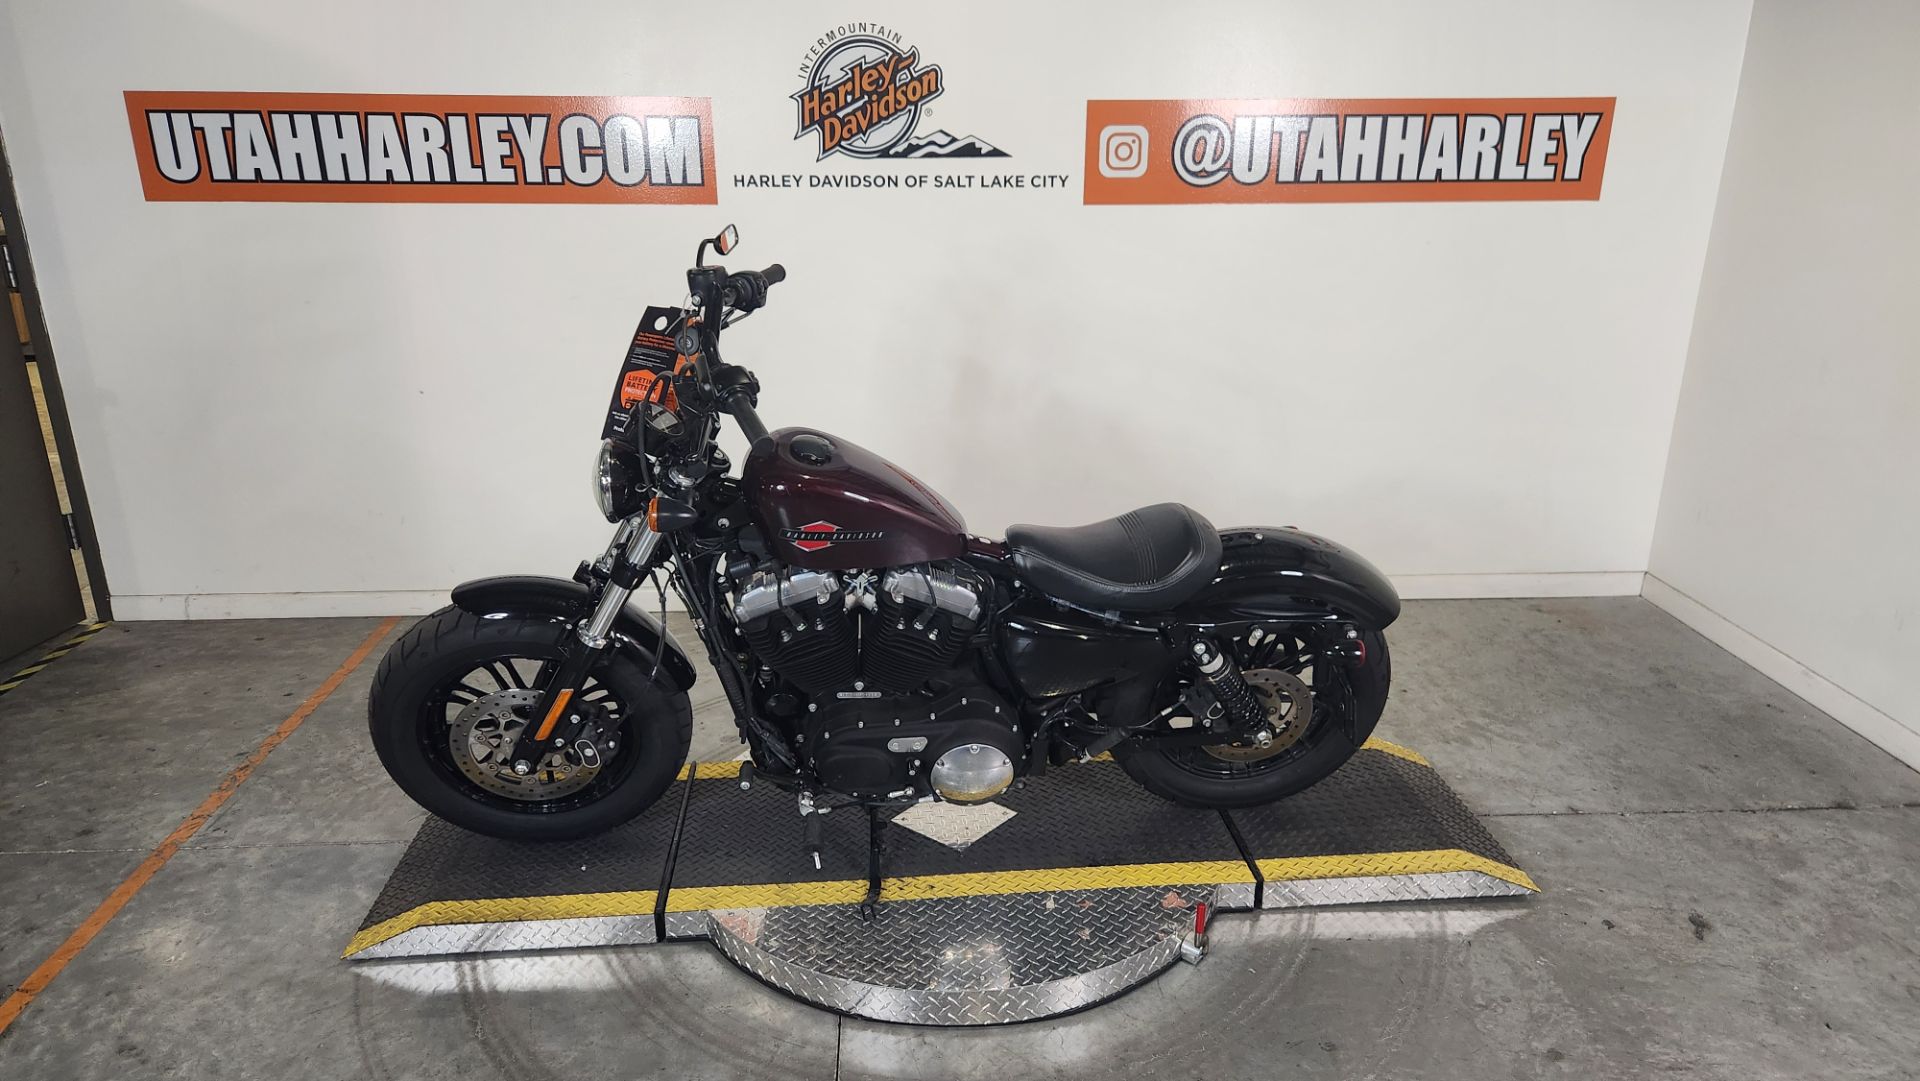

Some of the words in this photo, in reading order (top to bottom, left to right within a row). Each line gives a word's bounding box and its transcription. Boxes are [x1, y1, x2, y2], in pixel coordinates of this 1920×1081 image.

[798, 22, 902, 79] INTERMOUNTAIN
[823, 68, 939, 151] Davidson
[145, 109, 706, 188] UTAHHARLEY.COM
[733, 174, 804, 189] HARLEY
[808, 174, 899, 189] DAVIDSON
[903, 174, 929, 189] OF
[933, 174, 975, 189] SALT
[980, 174, 1026, 189] LAKE
[1030, 174, 1070, 189] CITY
[1171, 112, 1604, 188] @UTAHHARLEY
